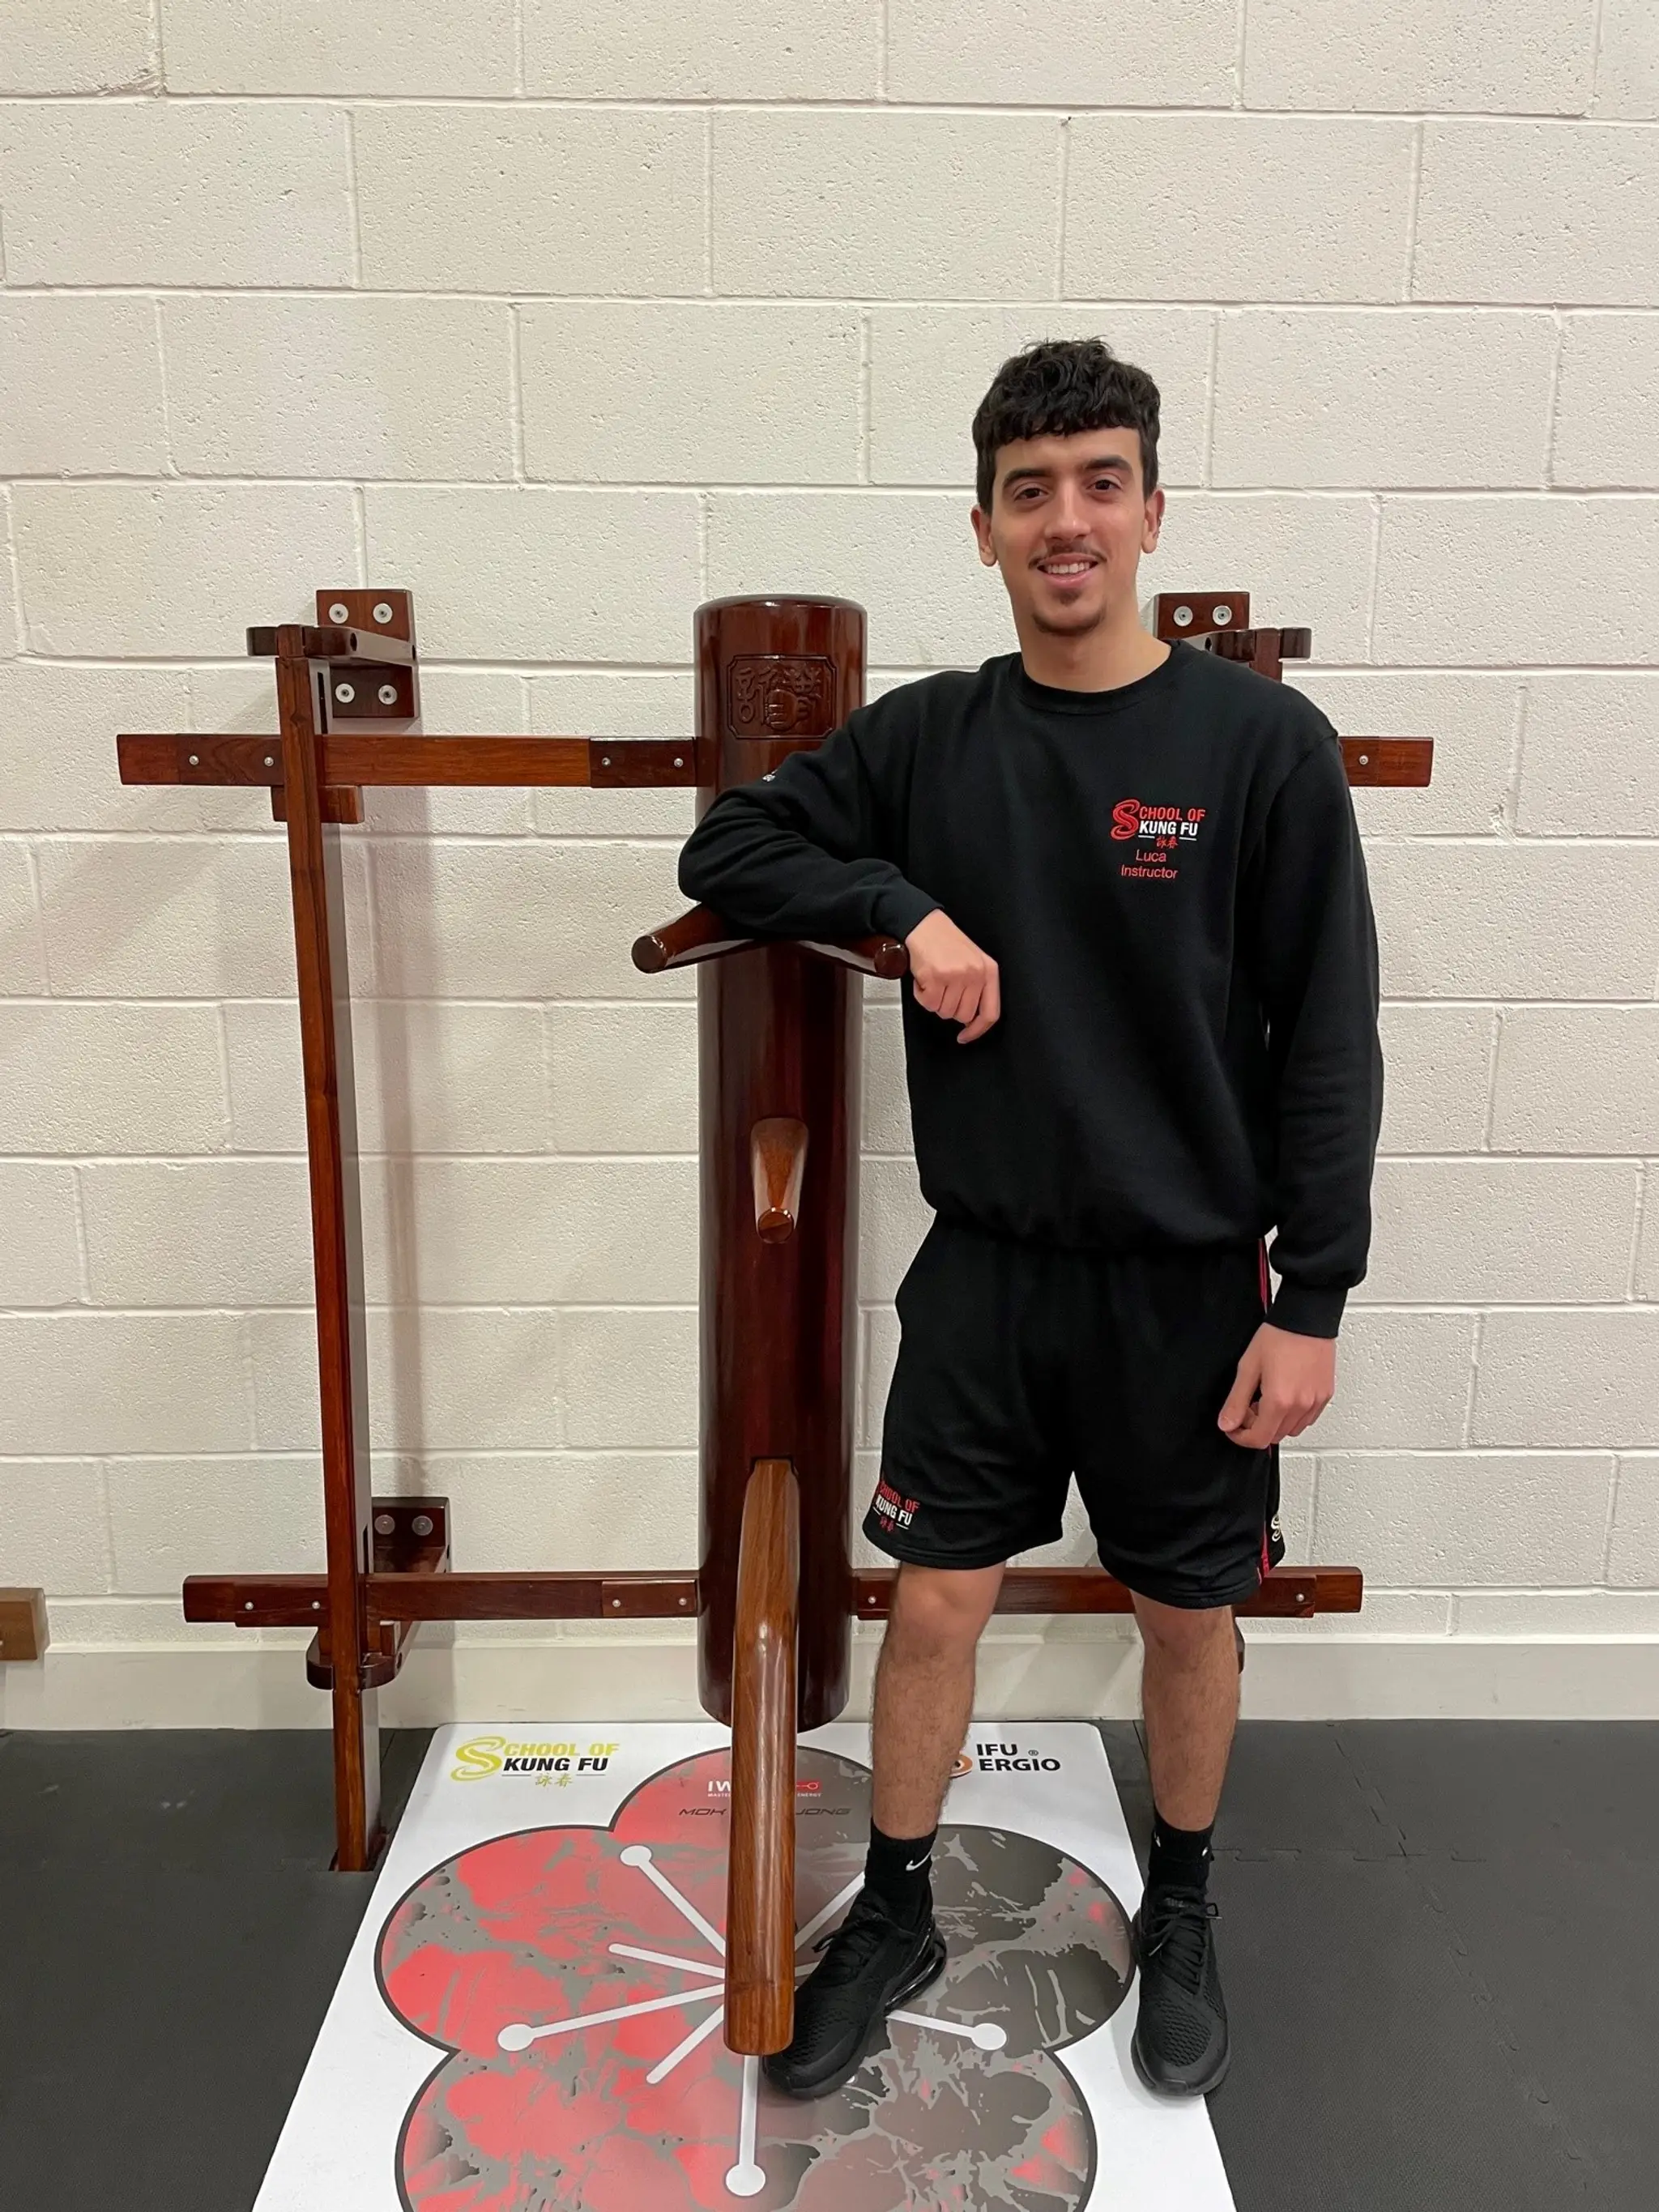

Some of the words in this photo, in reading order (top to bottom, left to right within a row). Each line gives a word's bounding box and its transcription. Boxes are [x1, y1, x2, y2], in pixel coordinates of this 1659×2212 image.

[1110, 799, 1183, 840] SCHOOL
[1187, 808, 1206, 822] OF
[1138, 821, 1177, 835] KUNG
[1180, 822, 1199, 836] FU
[1136, 849, 1167, 863] Luca
[1121, 864, 1179, 880] Instructor
[905, 1498, 920, 1513] OF
[898, 1509, 913, 1525] FU
[450, 1735, 580, 1782] SCHOOL
[589, 1743, 620, 1756] OF
[503, 1757, 569, 1771] KUNG
[578, 1758, 608, 1771] FU
[679, 1808, 727, 1816] MOK
[795, 1808, 852, 1816] JONG
